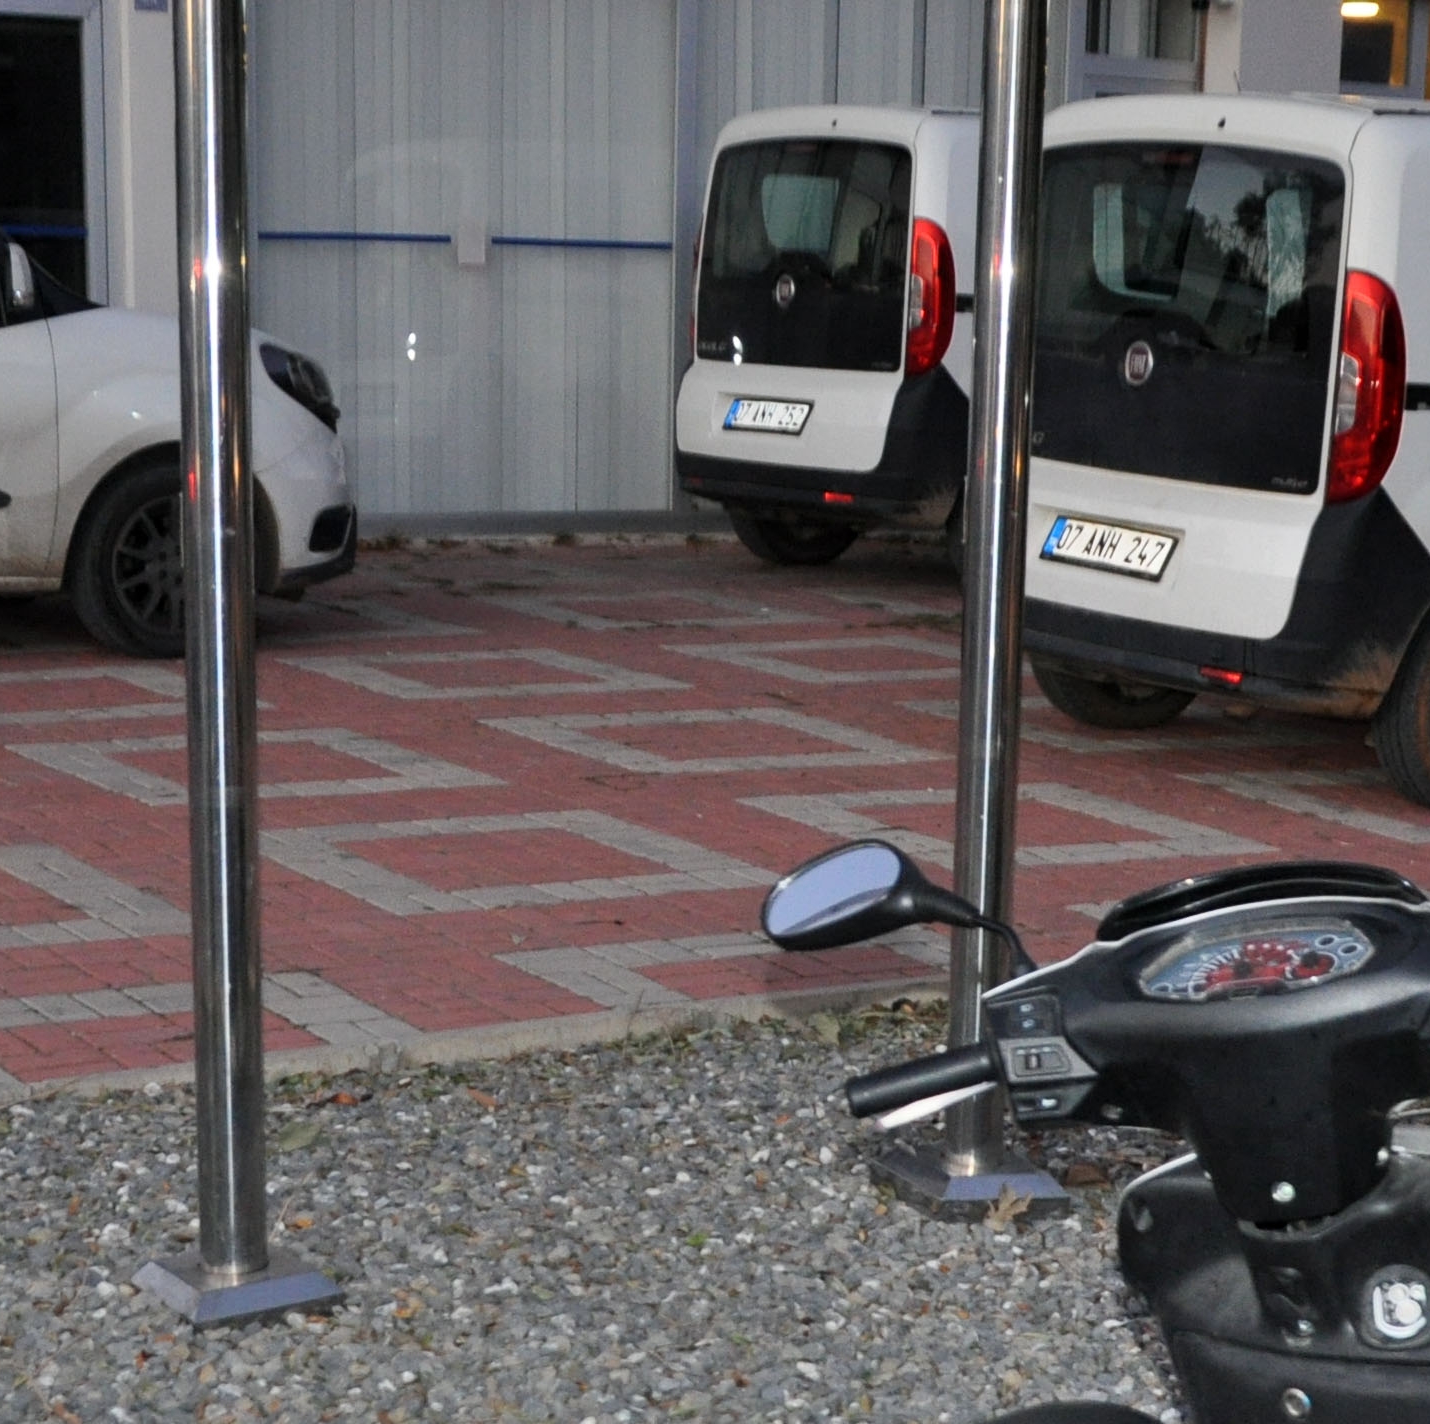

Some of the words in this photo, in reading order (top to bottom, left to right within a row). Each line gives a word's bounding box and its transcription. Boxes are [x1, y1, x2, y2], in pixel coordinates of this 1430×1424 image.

[1056, 523, 1085, 551] 07
[1082, 527, 1123, 560] ANH
[1123, 536, 1166, 568] 247
